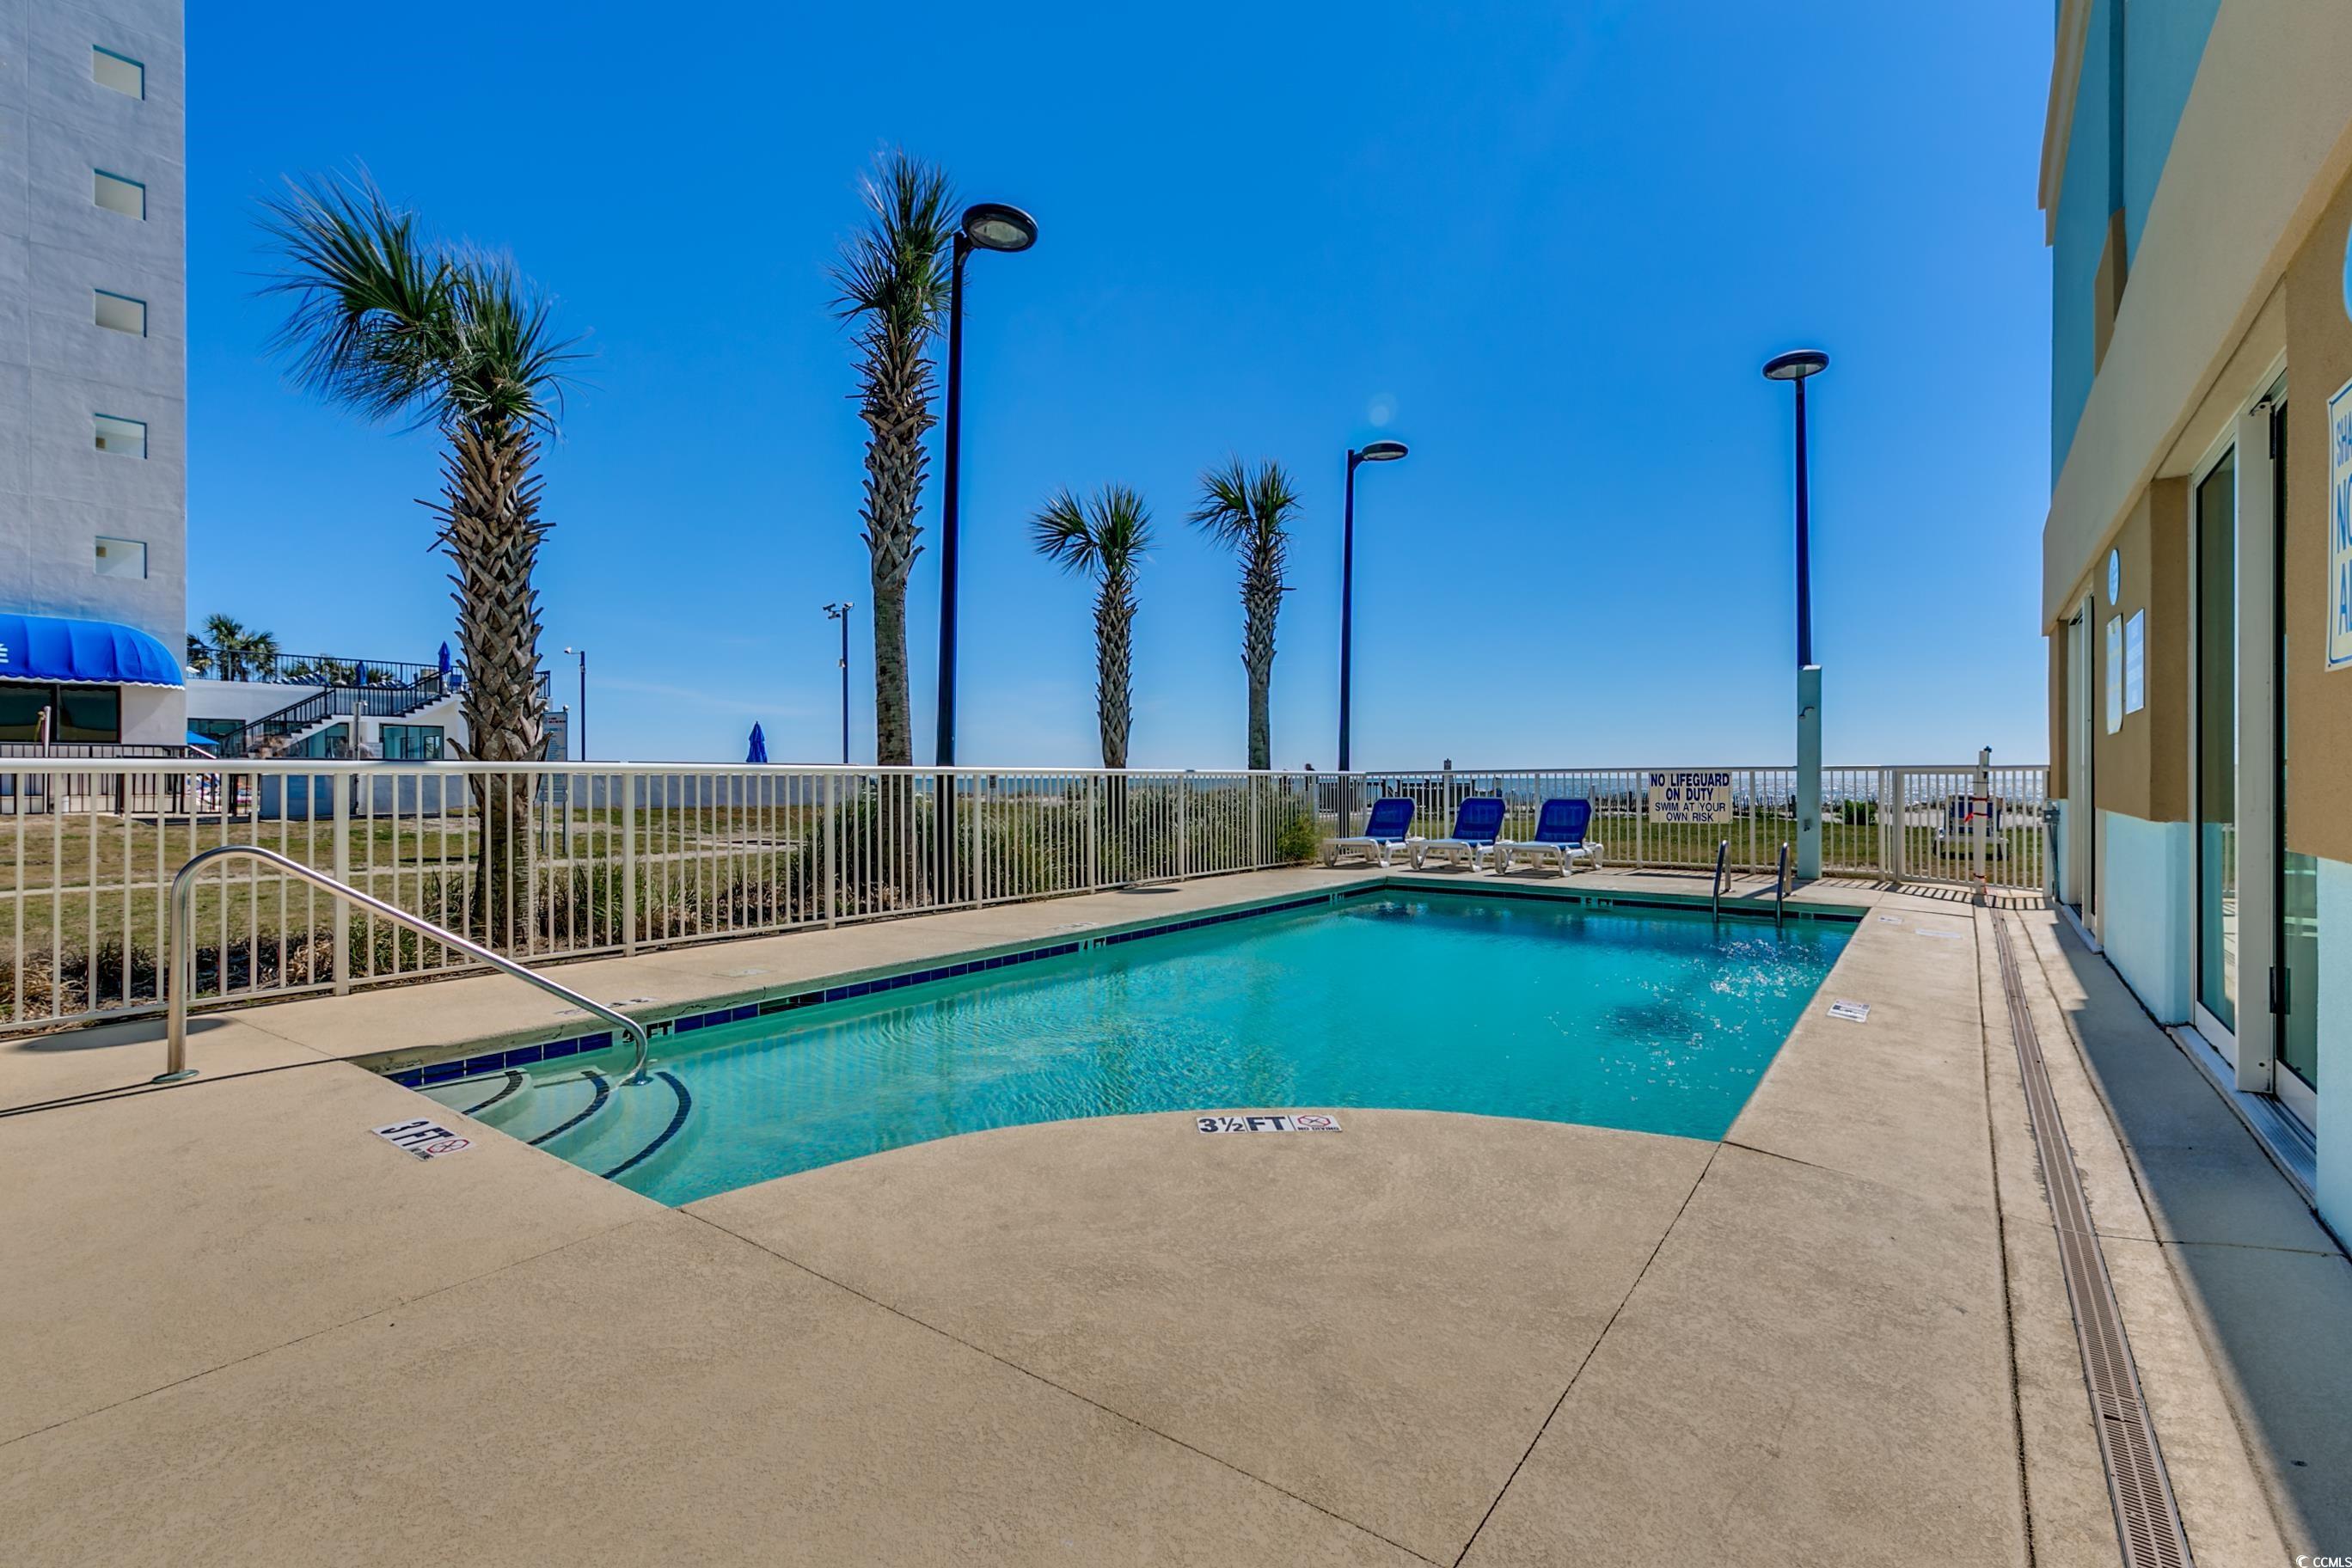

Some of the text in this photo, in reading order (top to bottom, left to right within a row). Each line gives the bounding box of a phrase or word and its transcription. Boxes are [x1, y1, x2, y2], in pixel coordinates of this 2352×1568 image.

[1651, 774, 1730, 787] NO LIFEGUARD
[1666, 787, 1713, 801] ON DUTY
[1655, 802, 1725, 812] SWIM AT YOUR
[1666, 812, 1713, 822] OWN RISK
[646, 1020, 673, 1039] FT
[1246, 1116, 1286, 1131] FT
[380, 1120, 455, 1147] 3 FT
